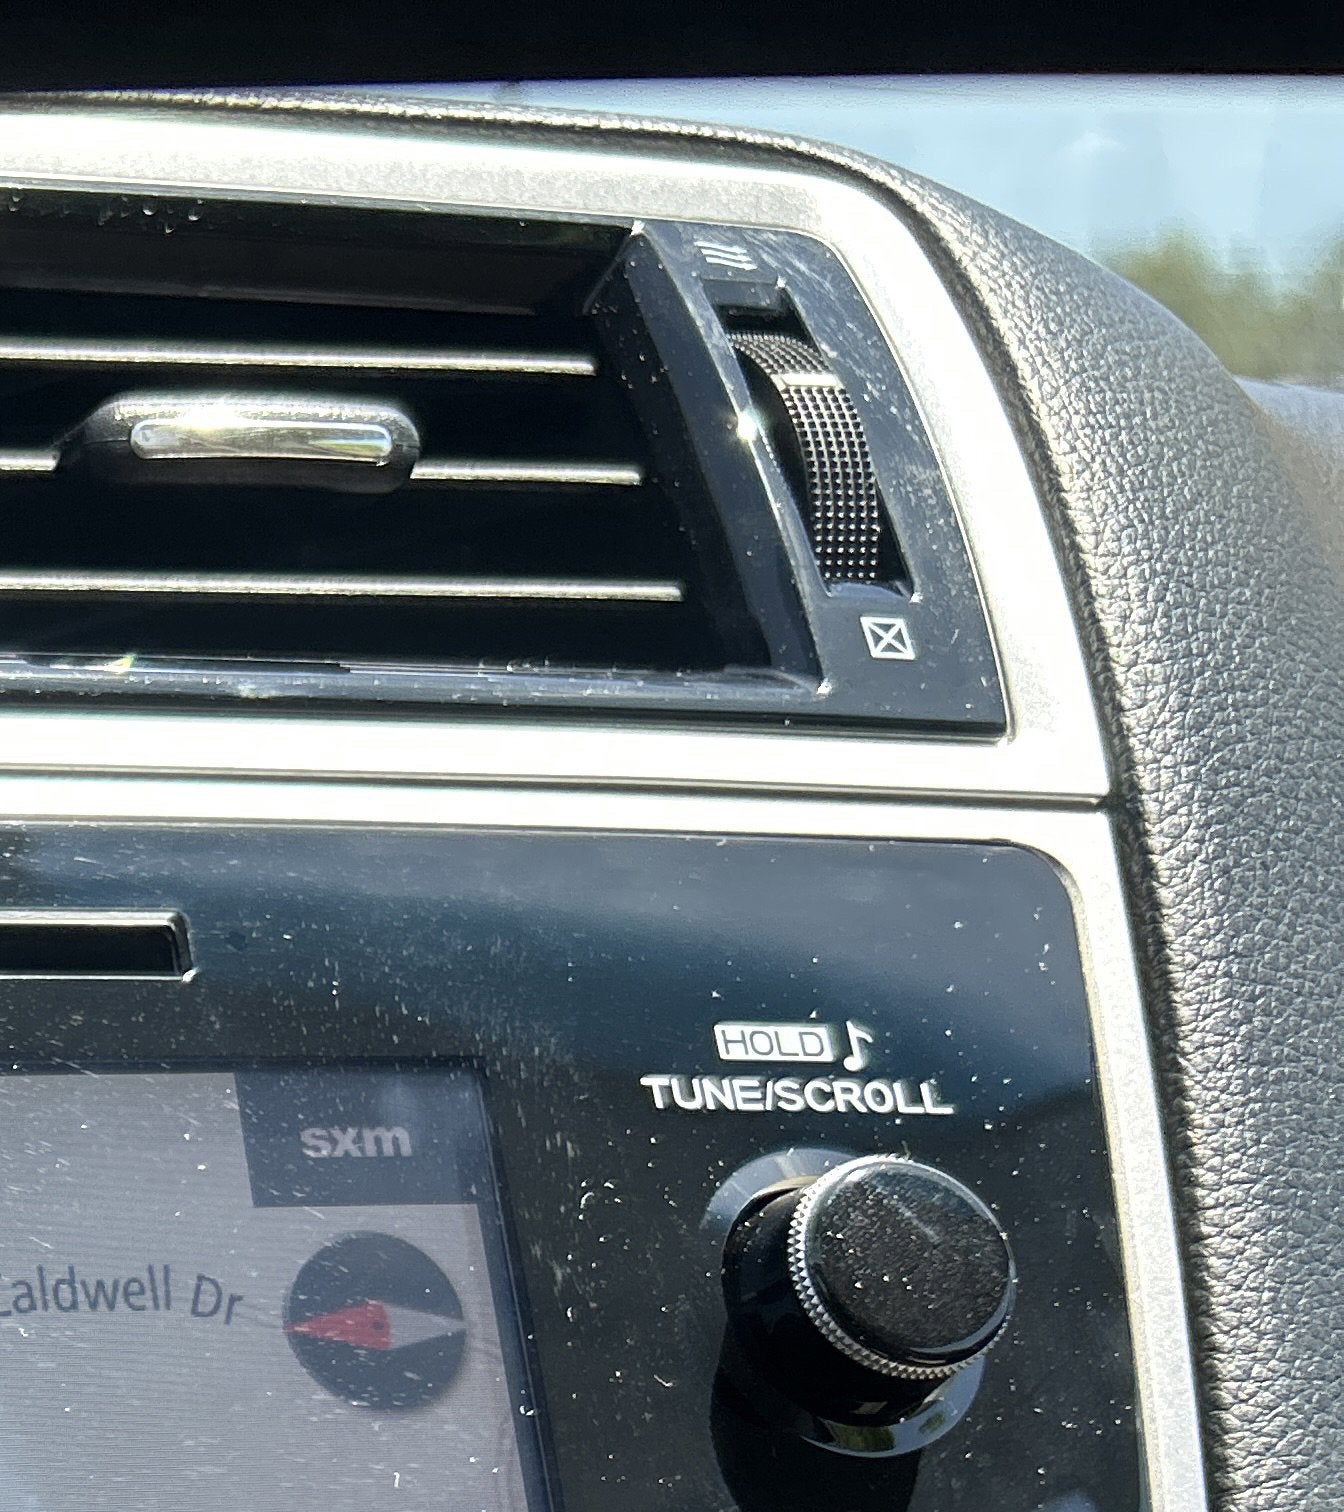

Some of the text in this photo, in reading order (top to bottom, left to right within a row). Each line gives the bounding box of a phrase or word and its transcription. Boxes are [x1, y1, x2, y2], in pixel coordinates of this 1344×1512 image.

[720, 1029, 825, 1058] HOLD
[639, 1075, 956, 1116] TUNE/SCROLL
[300, 1122, 413, 1158] sxm
[191, 1274, 245, 1325] Dr
